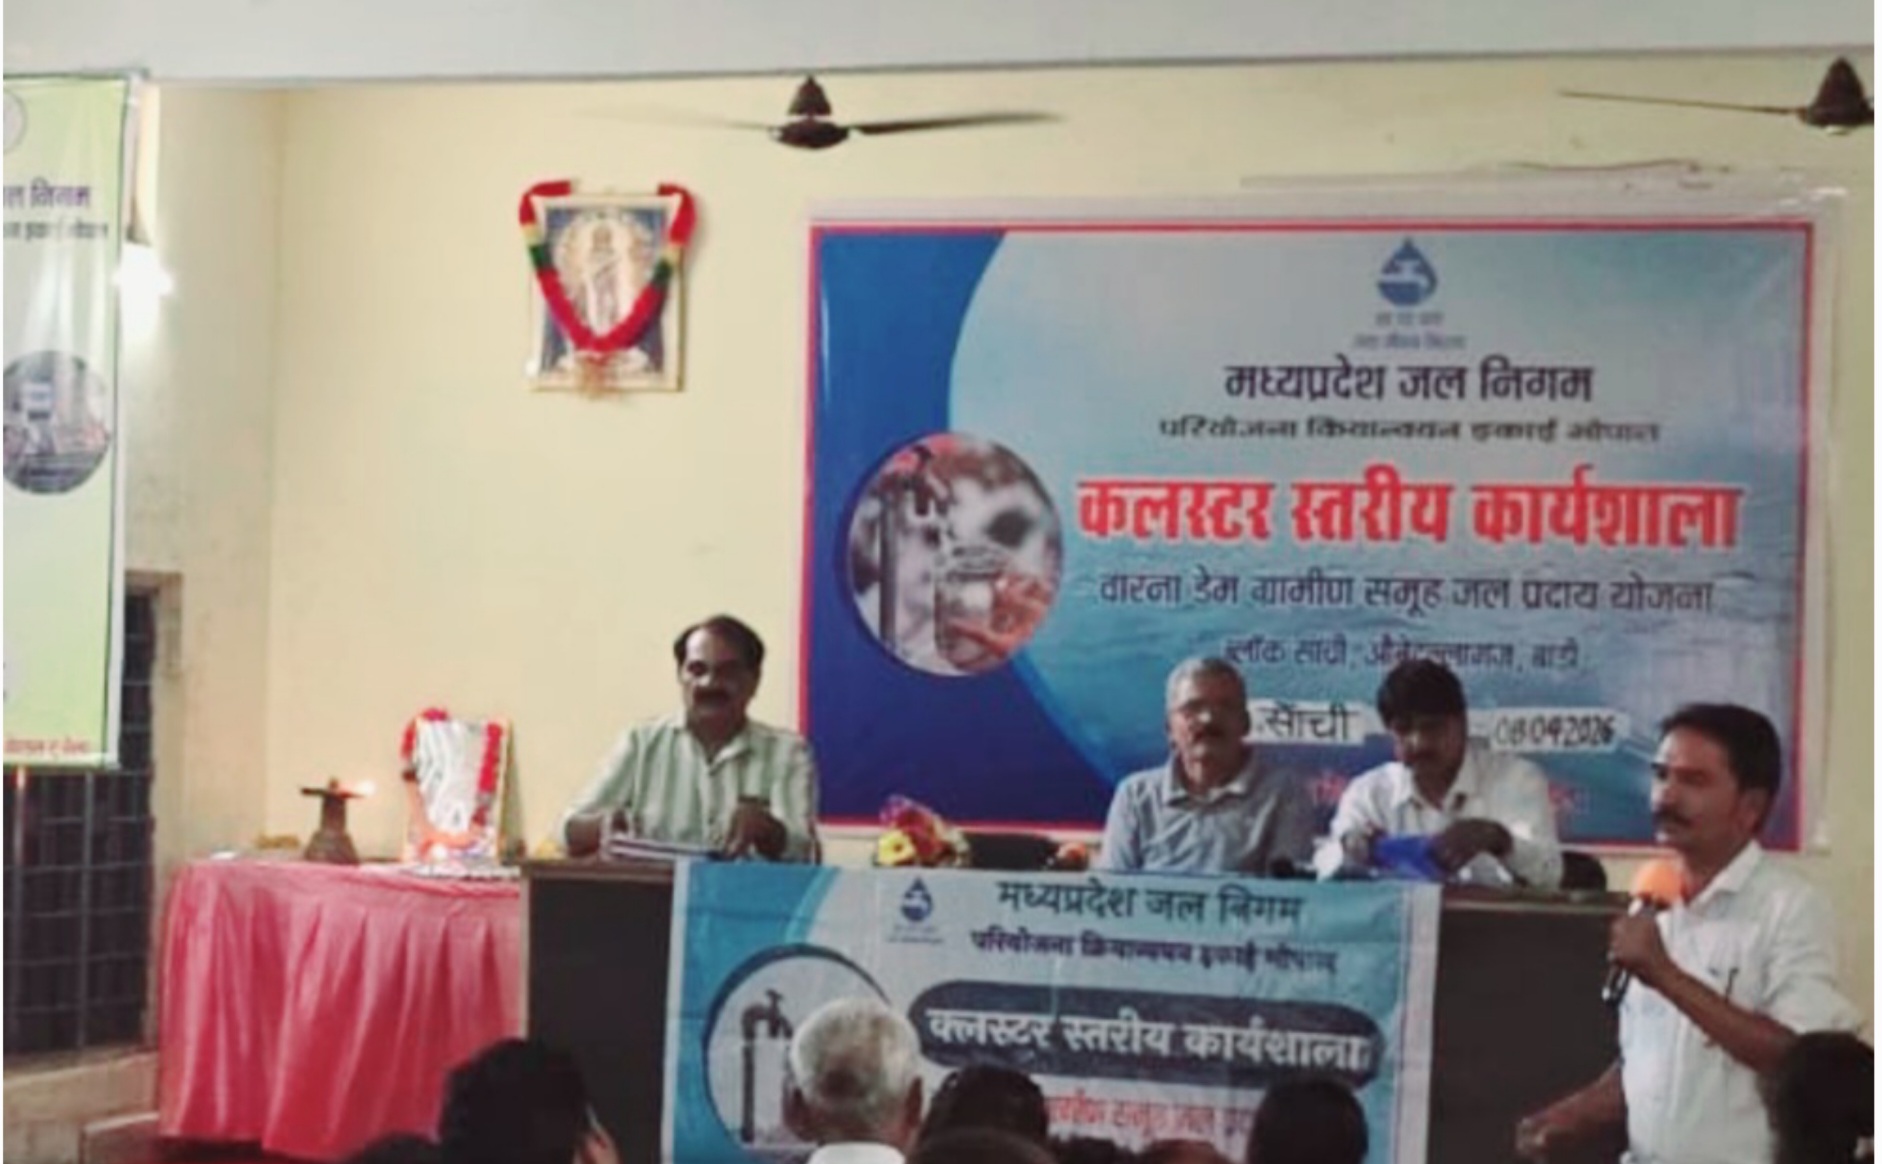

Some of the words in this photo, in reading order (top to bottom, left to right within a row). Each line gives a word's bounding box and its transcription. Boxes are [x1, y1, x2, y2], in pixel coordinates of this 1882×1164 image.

[1224, 353, 1386, 401] मध्यप्रदेश
[1397, 365, 1467, 400] जल
[1480, 354, 1594, 401] निगम
[1077, 479, 1276, 541] कलस्टर
[1290, 462, 1454, 544] स्तरीय
[1470, 462, 1745, 548] कार्यशाला
[1363, 576, 1445, 618] समूह
[1451, 577, 1512, 610] जल
[1520, 579, 1600, 611] प्रदाय
[1608, 569, 1715, 612] योजना
[996, 875, 1136, 920] मध्यप्रदेश
[1145, 888, 1208, 922] जल
[1218, 882, 1306, 925] निगम
[1059, 1007, 1175, 1057] स्तरीय
[1180, 1016, 1371, 1069] कार्यशाला
